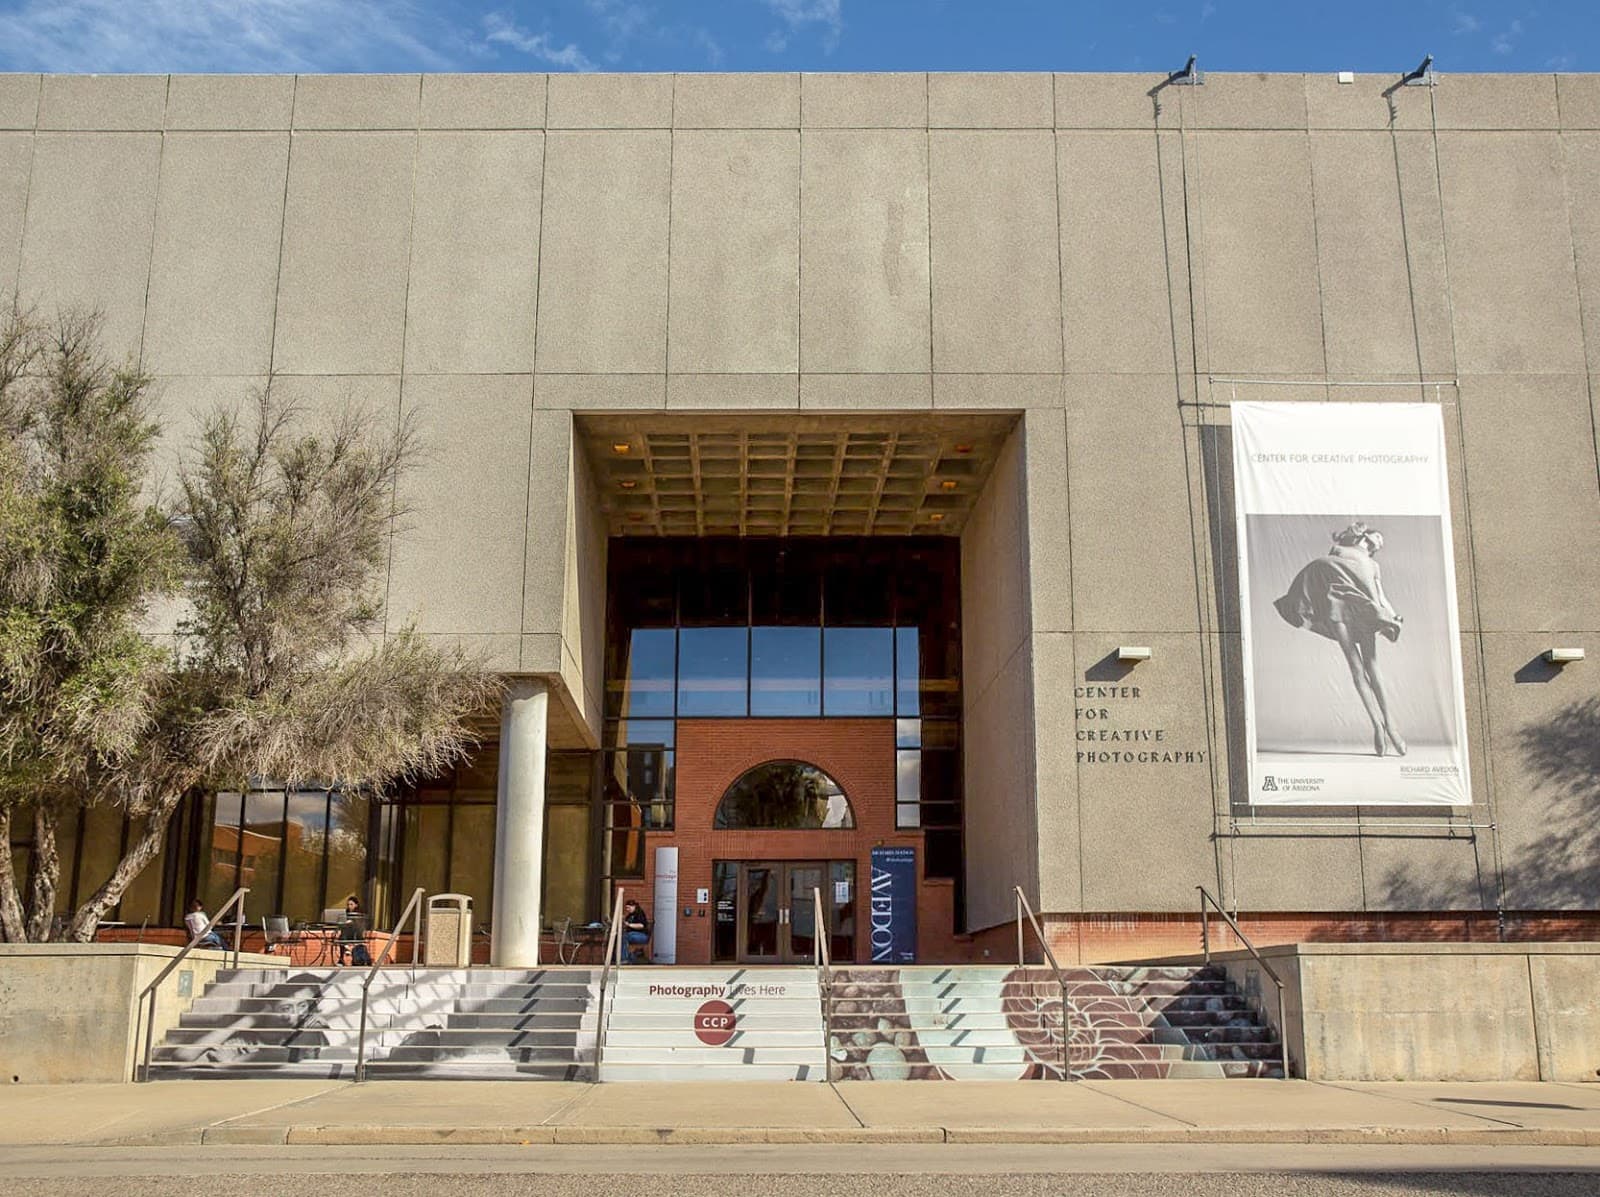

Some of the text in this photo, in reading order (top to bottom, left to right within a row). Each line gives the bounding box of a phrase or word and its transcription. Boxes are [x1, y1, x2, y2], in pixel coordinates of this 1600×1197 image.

[1250, 453, 1429, 464] CENTER FOR CREATIVE PHOTOGRAPHY
[1074, 686, 1142, 699] CENTER
[1075, 708, 1109, 720] FOR
[1075, 729, 1165, 742] CREATIVE
[1076, 751, 1207, 763] PHOTOGRAPHY
[1278, 777, 1325, 785] THE UNIVERSITY
[871, 865, 892, 963] AVEDON
[649, 984, 726, 997] Photography
[759, 984, 786, 996] Here
[702, 1016, 729, 1028] CCP
